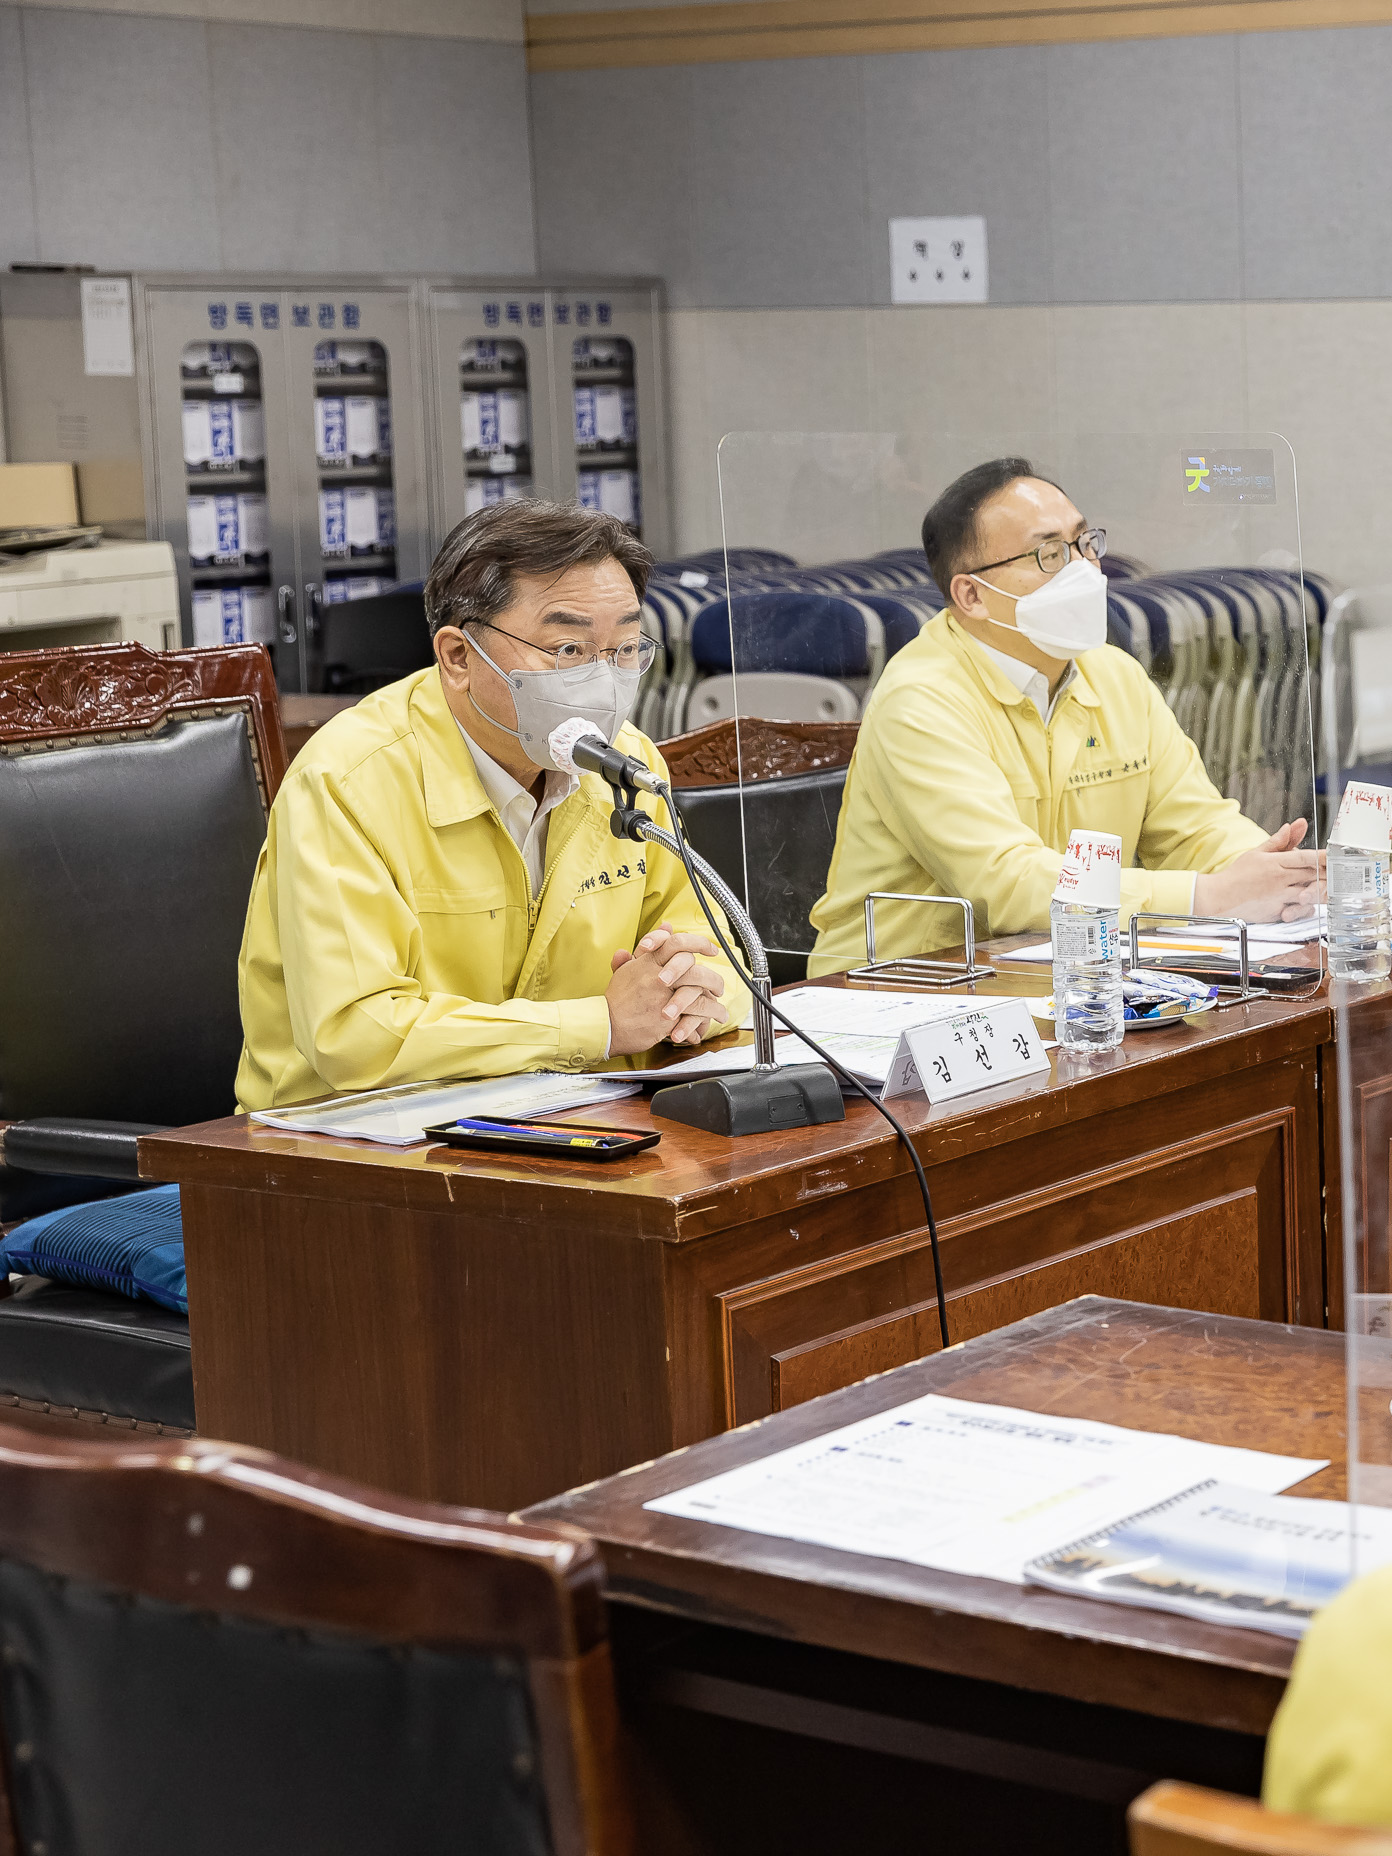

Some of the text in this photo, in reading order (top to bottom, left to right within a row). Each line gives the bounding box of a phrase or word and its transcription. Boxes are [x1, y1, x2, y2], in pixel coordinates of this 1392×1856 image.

[207, 301, 280, 330] 방독면
[1099, 920, 1109, 960] water
[953, 1022, 995, 1046] 구청장
[932, 1033, 1031, 1084] 김선갑
